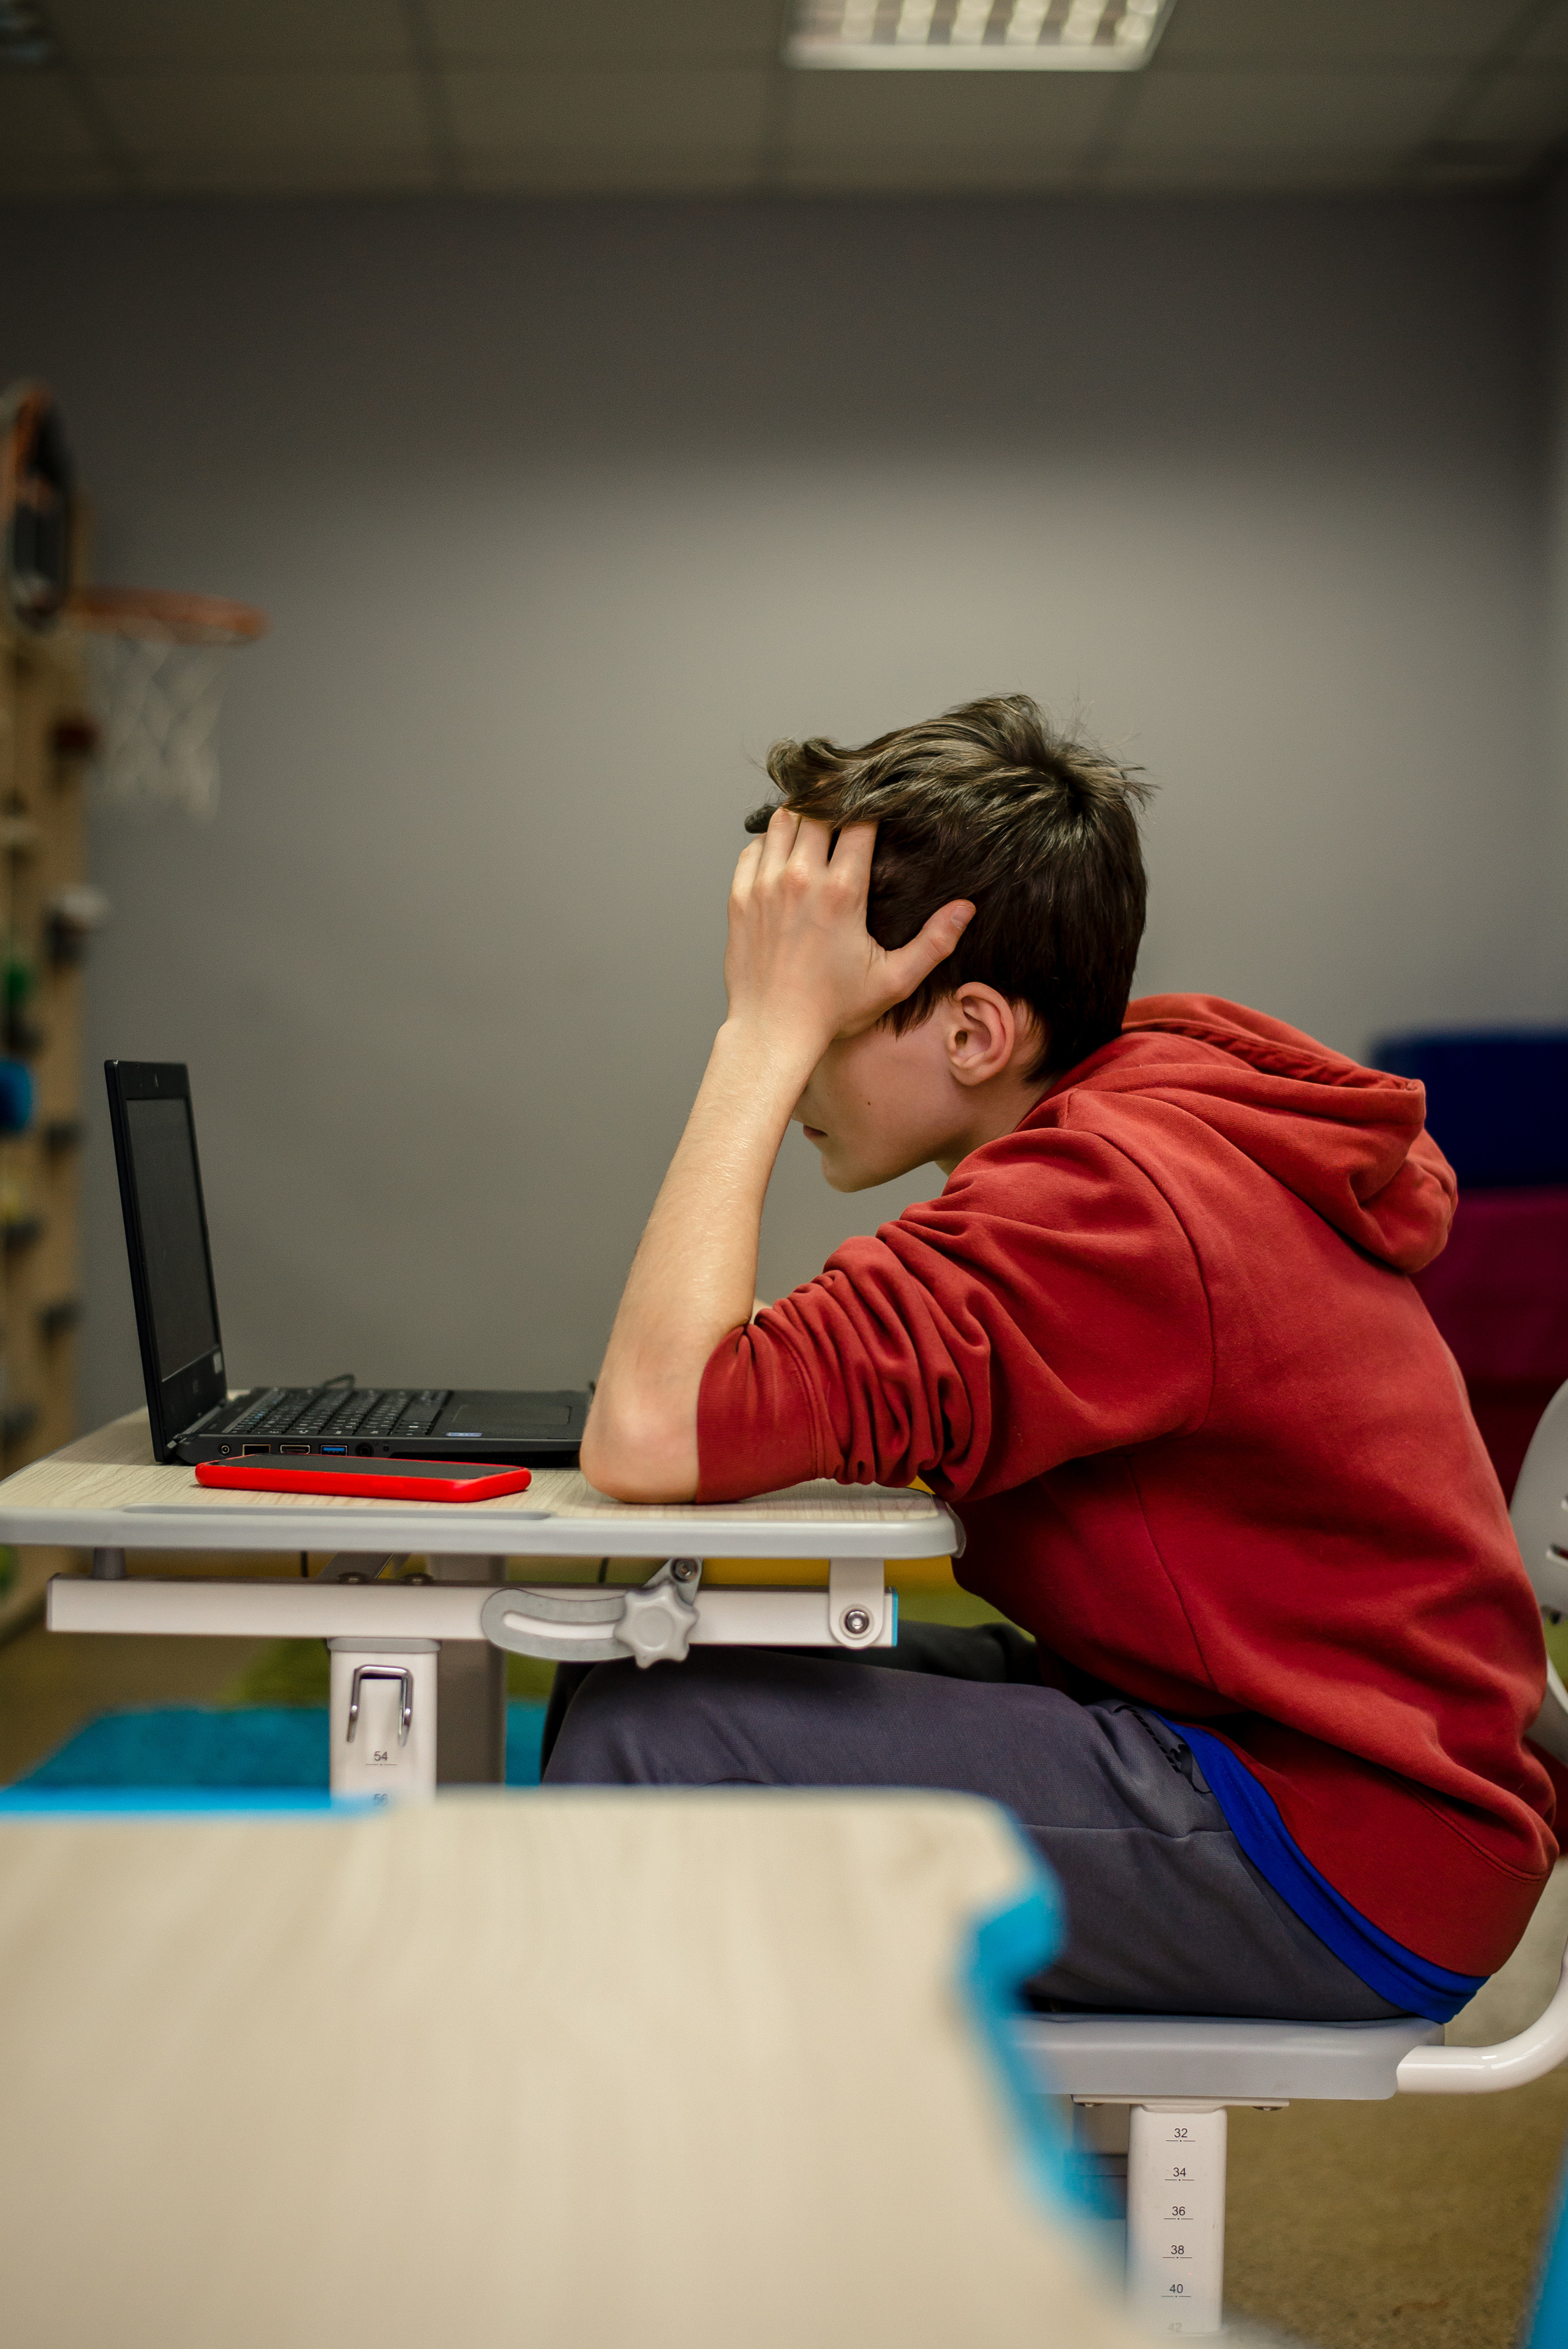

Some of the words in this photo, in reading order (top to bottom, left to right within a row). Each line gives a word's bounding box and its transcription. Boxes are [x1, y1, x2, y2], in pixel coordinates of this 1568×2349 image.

[374, 1751, 388, 1761] 54
[1174, 2128, 1188, 2138] 32
[1173, 2167, 1187, 2177] 34
[1172, 2206, 1186, 2216] 36
[1170, 2245, 1185, 2255] 38
[1169, 2283, 1184, 2294] 40
[1167, 2322, 1183, 2332] 42
